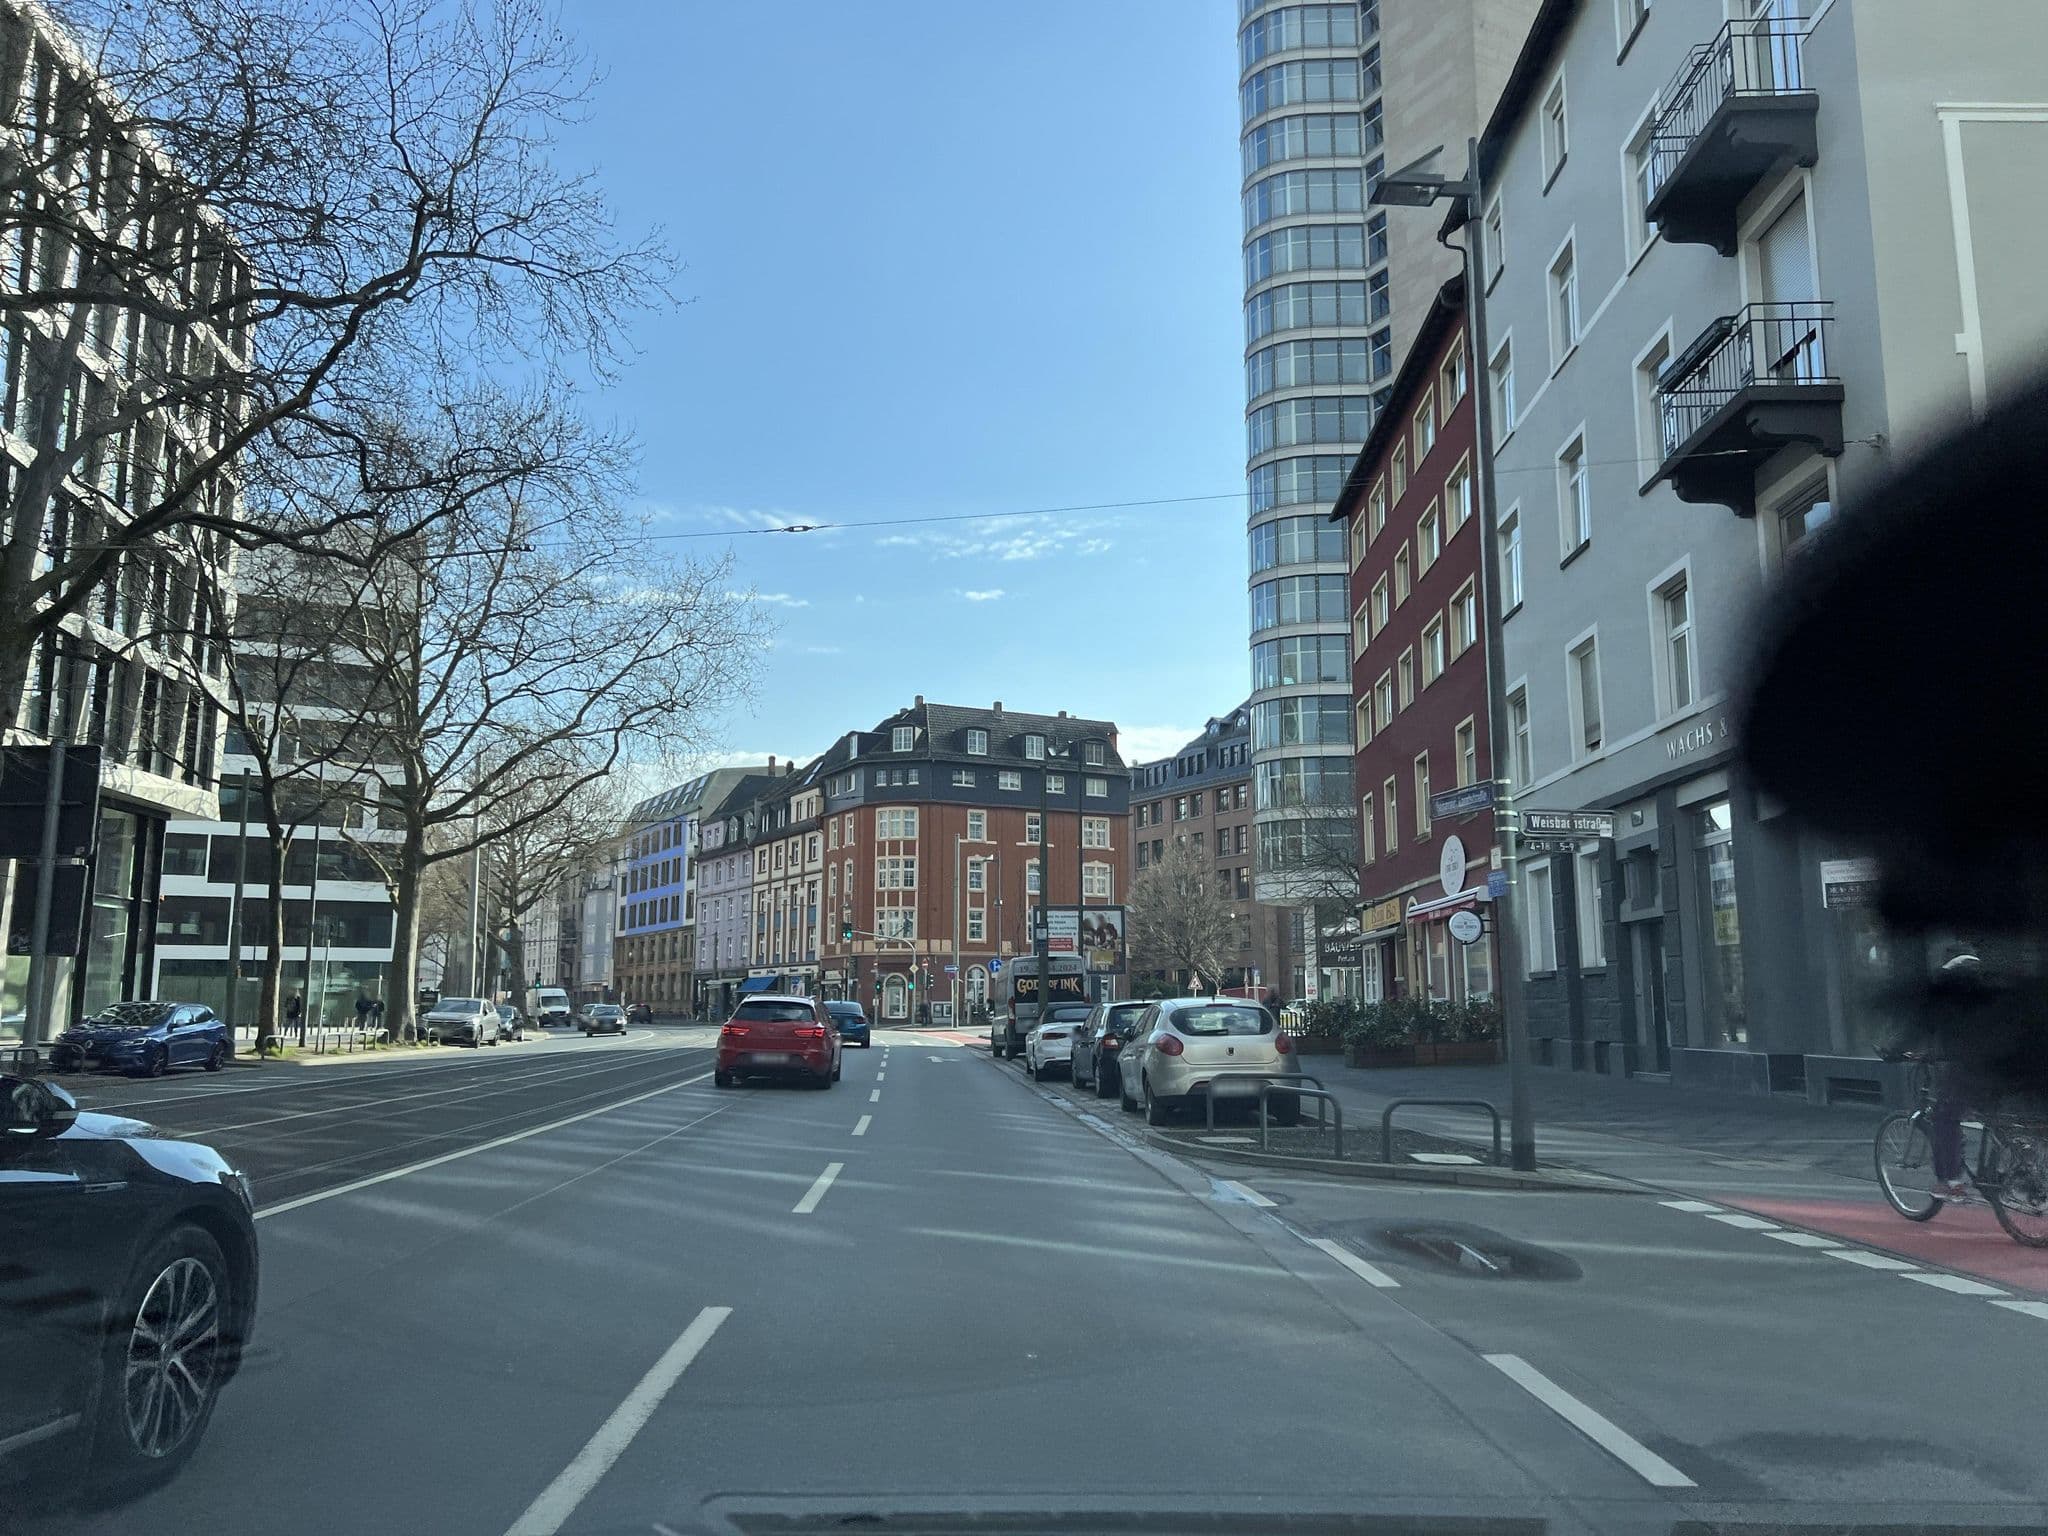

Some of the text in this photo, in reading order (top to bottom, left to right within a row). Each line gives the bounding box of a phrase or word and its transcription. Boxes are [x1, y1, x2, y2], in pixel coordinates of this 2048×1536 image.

[1666, 722, 1713, 760] WACHS
[1016, 977, 1081, 996] GOD OF INK
